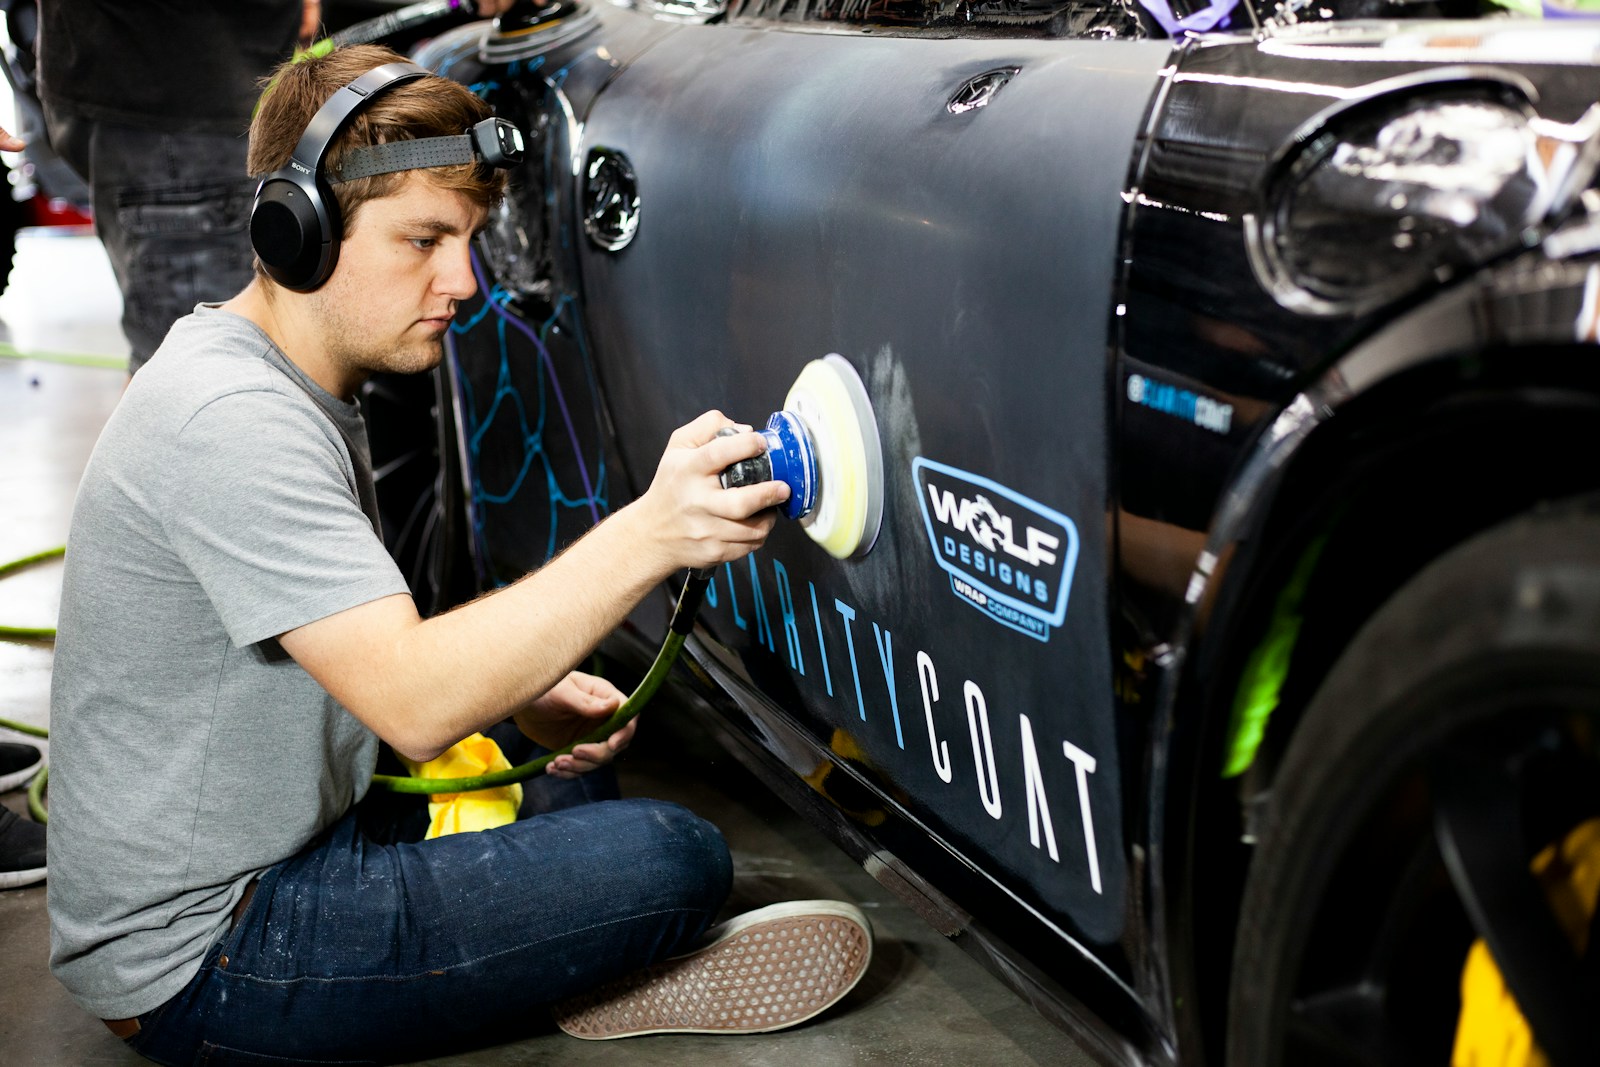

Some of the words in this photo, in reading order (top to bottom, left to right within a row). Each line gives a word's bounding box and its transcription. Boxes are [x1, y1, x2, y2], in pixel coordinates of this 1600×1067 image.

[291, 162, 311, 175] SONY
[928, 483, 1060, 567] WOLF
[944, 536, 1049, 603] DESIGNS
[953, 578, 988, 606] WRAP
[987, 598, 1045, 635] COMPANY
[705, 551, 1102, 895] LARITYCOAT
